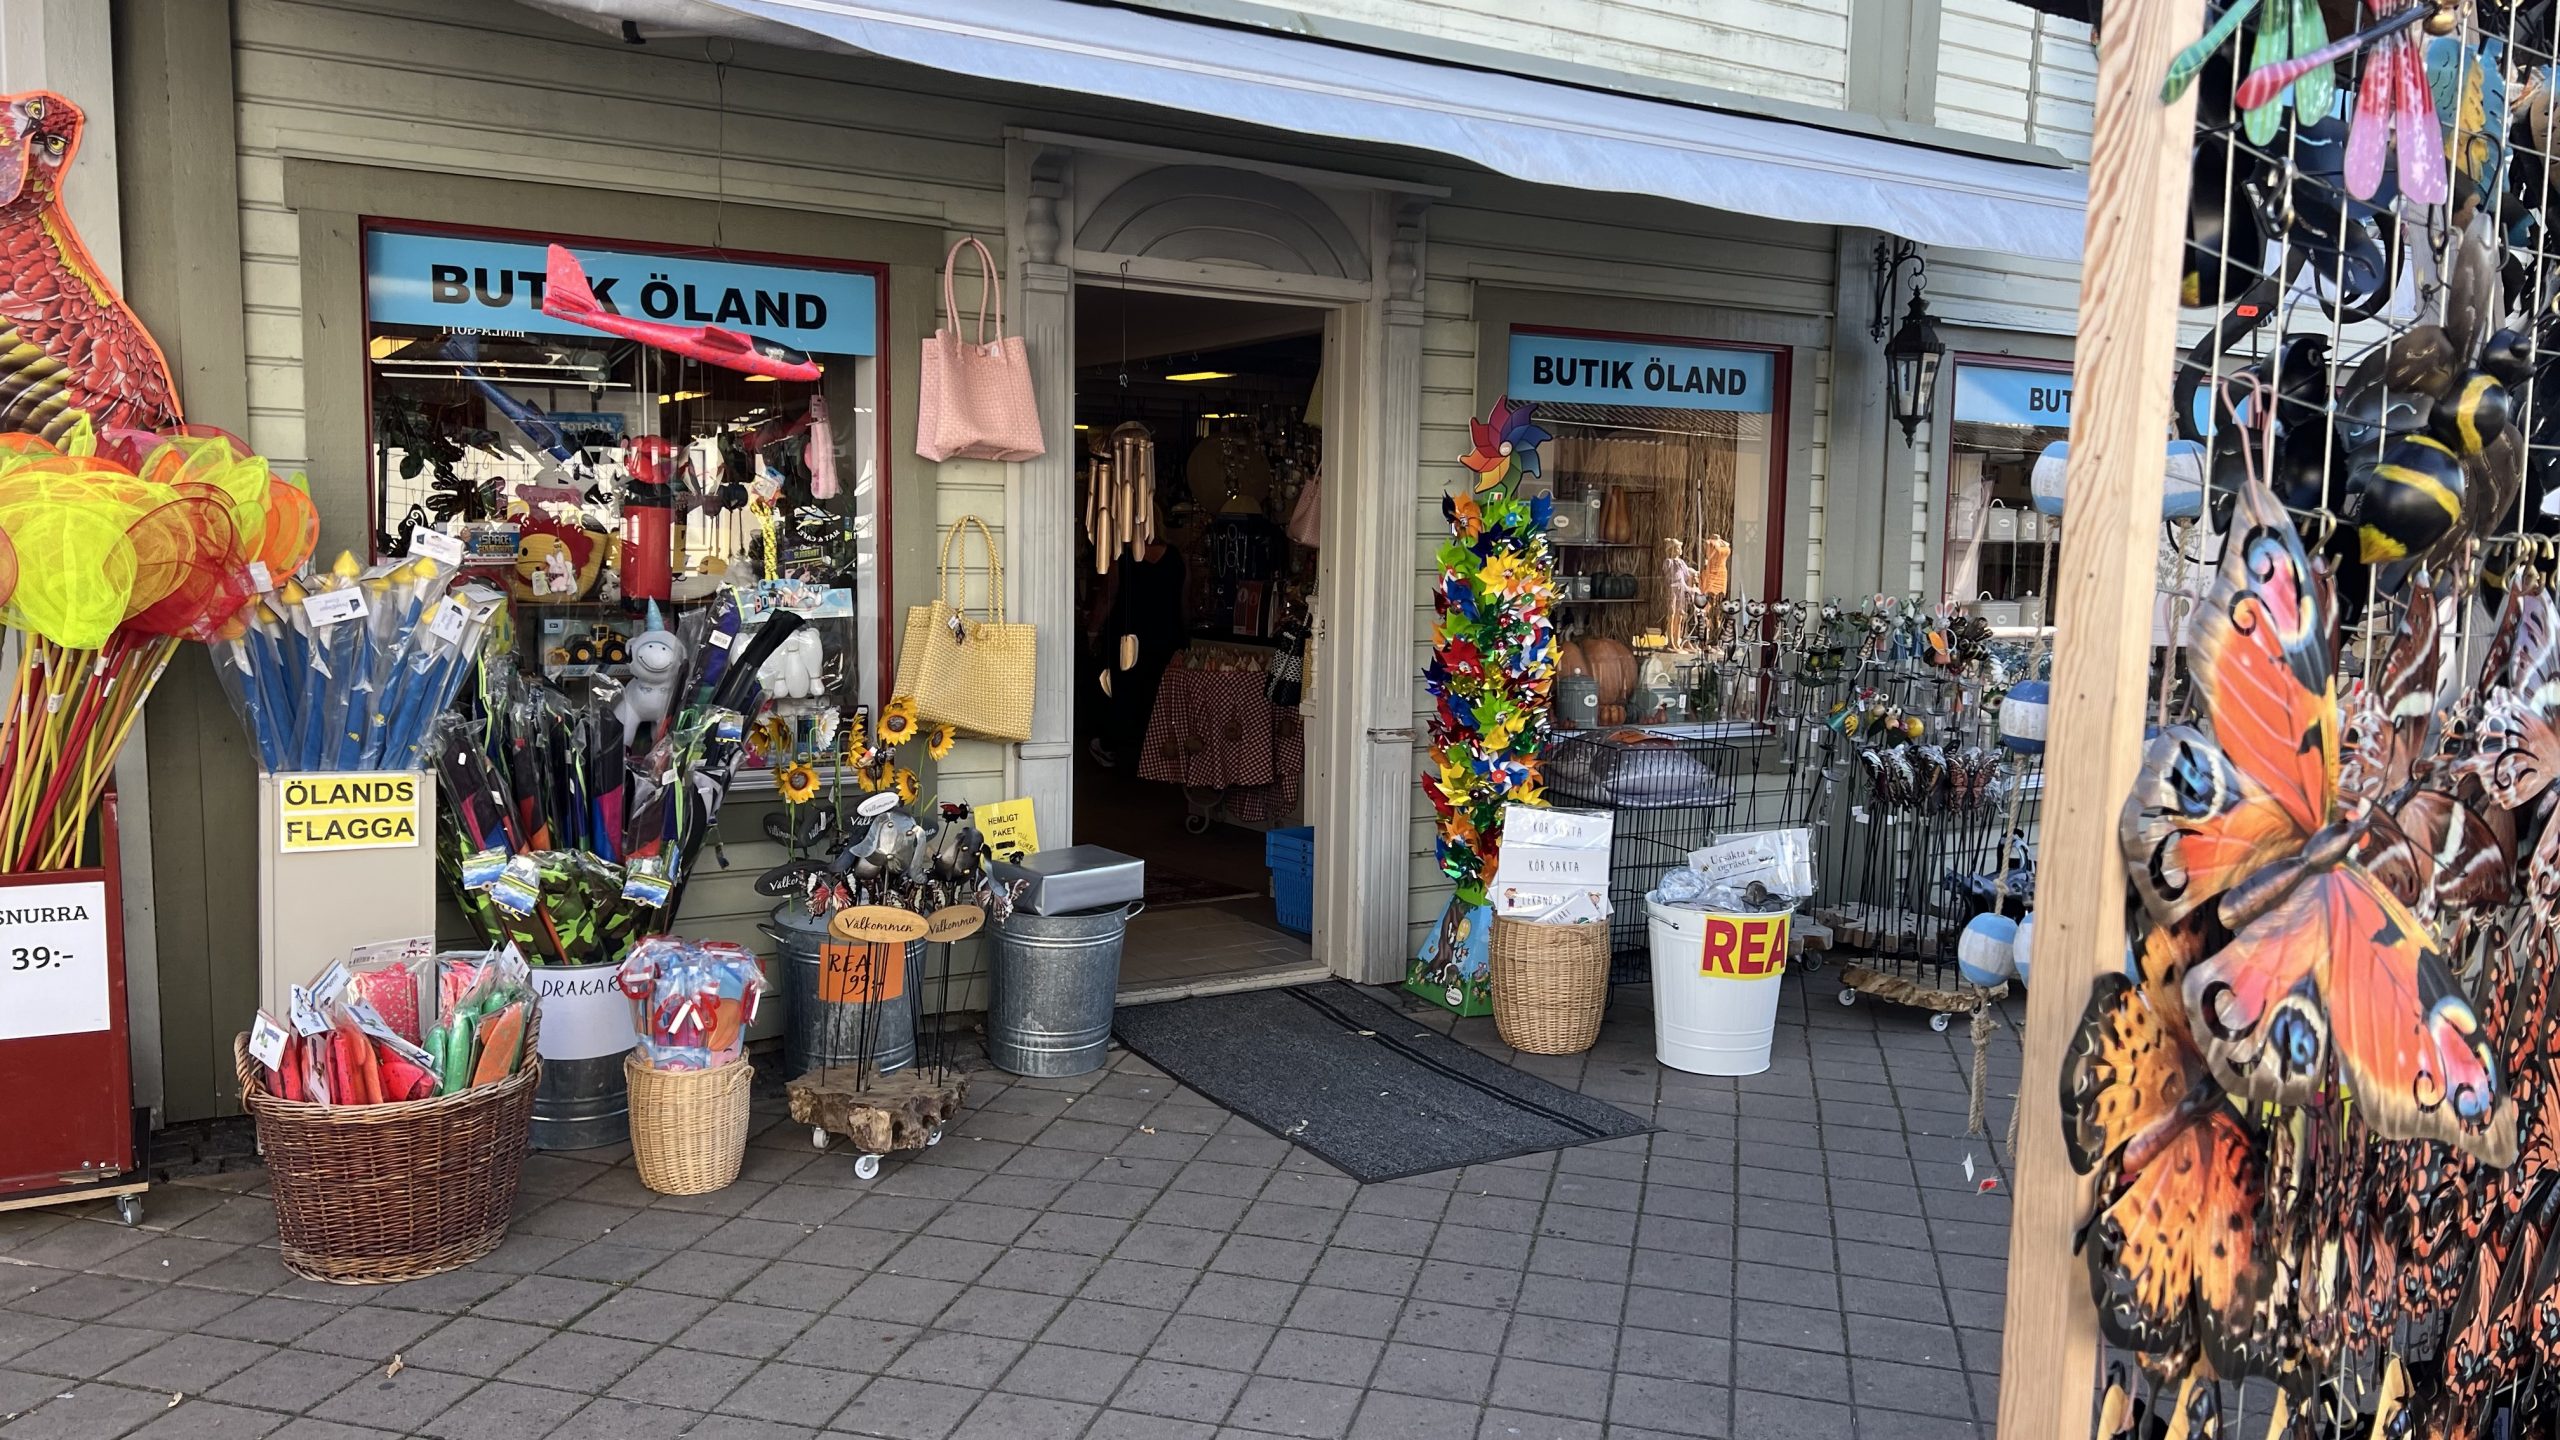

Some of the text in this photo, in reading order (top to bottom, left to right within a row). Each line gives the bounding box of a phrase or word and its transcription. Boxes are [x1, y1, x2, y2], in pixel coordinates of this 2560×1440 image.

[431, 264, 828, 330] BUTK ÖLAND
[1533, 355, 1747, 396] BUTIK ÖLAND
[285, 780, 414, 806] ÖLANDS
[286, 817, 415, 842] FLAGGA
[987, 813, 1019, 825] HEMLIGT
[992, 826, 1016, 838] PAKET
[1528, 858, 1580, 873] KÖR SAKTA
[1710, 849, 1746, 865] Ursäkta
[844, 916, 914, 933] Välkommen
[929, 915, 978, 936] Välkommen
[1702, 918, 1786, 975] REA
[12, 946, 74, 971] 39:-
[828, 953, 871, 973] REA
[541, 975, 621, 998] DRAKAR
